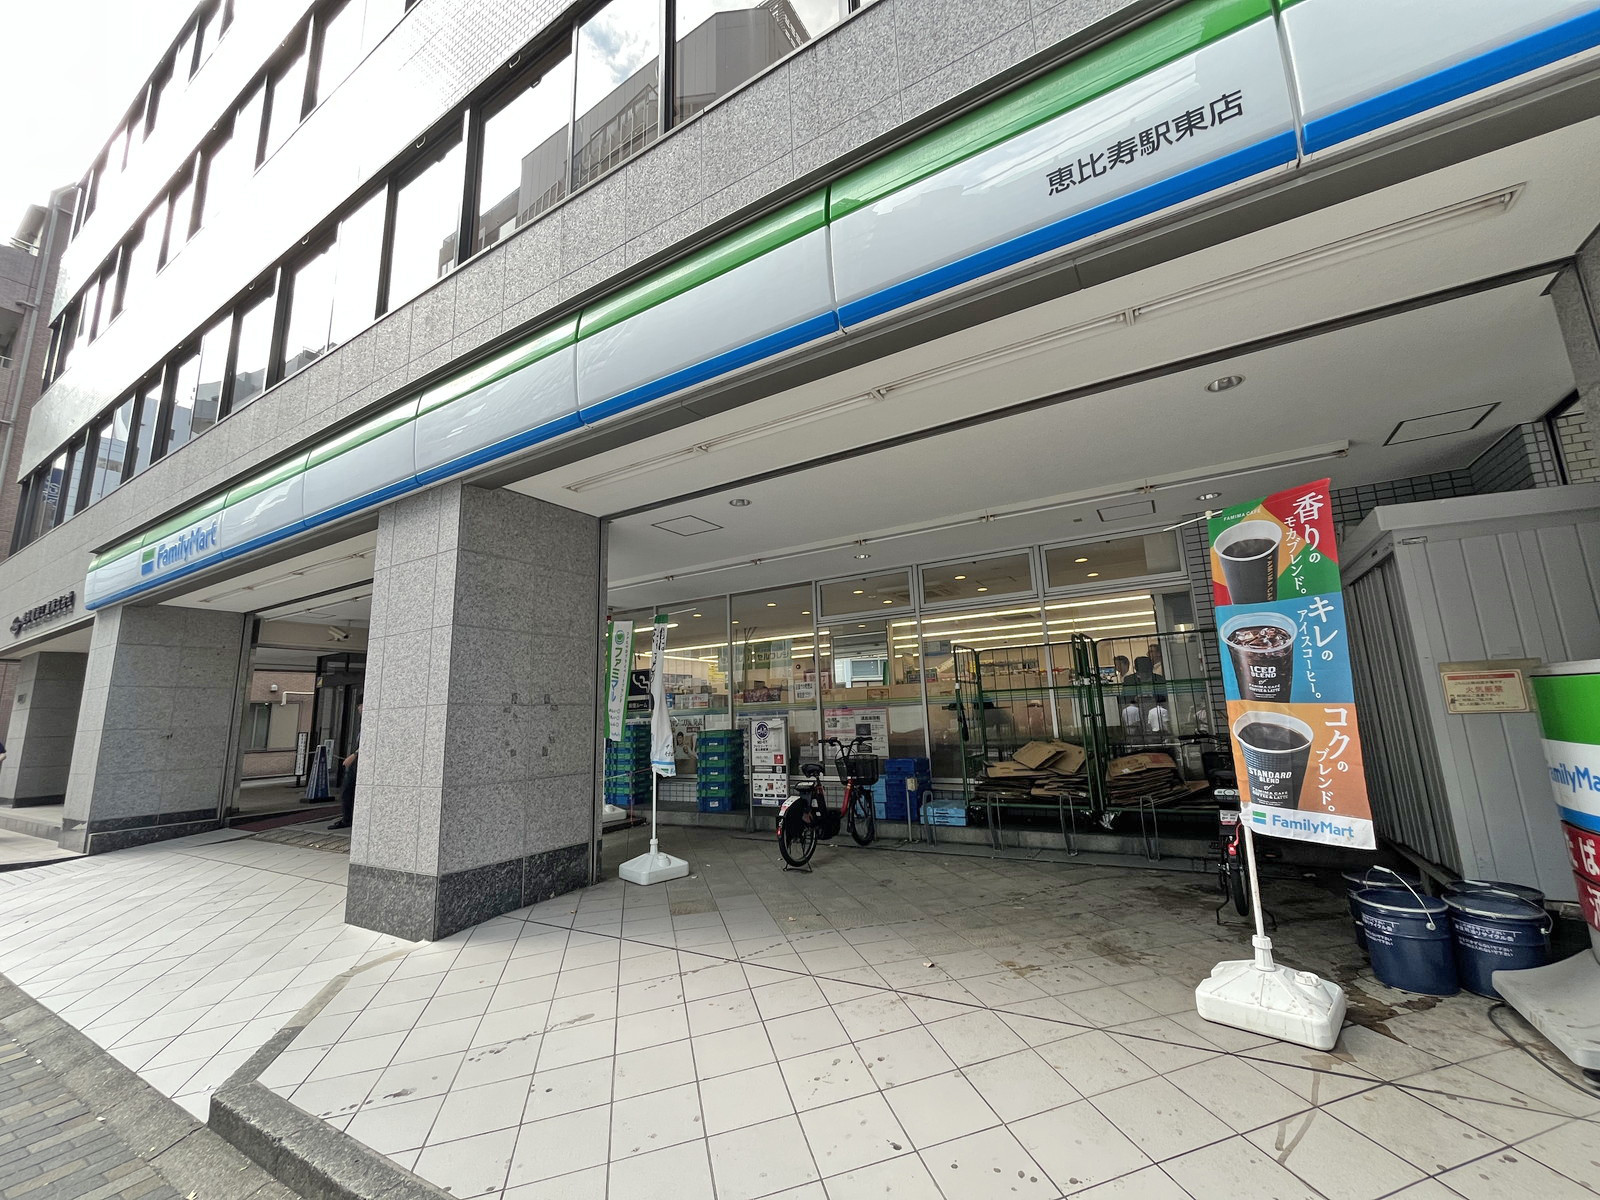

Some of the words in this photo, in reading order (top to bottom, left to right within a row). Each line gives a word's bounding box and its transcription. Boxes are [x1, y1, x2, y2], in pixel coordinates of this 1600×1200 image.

[1046, 90, 1243, 196] 恵比寿駅東店
[156, 520, 218, 569] FamilyMart
[1223, 512, 1246, 521] FAMIMA
[1292, 491, 1324, 564] 香りの
[1283, 516, 1307, 594] モカブレンド。
[1297, 609, 1322, 699] アイスコーヒー。
[1308, 596, 1339, 661] キレの
[611, 647, 622, 703] ファミマル
[1250, 665, 1277, 674] ICED
[1324, 707, 1350, 773] コクの
[1248, 767, 1293, 779] STANDARD
[1259, 776, 1280, 784] BLEND
[1316, 747, 1336, 812] ブレンド。
[1272, 814, 1354, 838] FamilyMart
